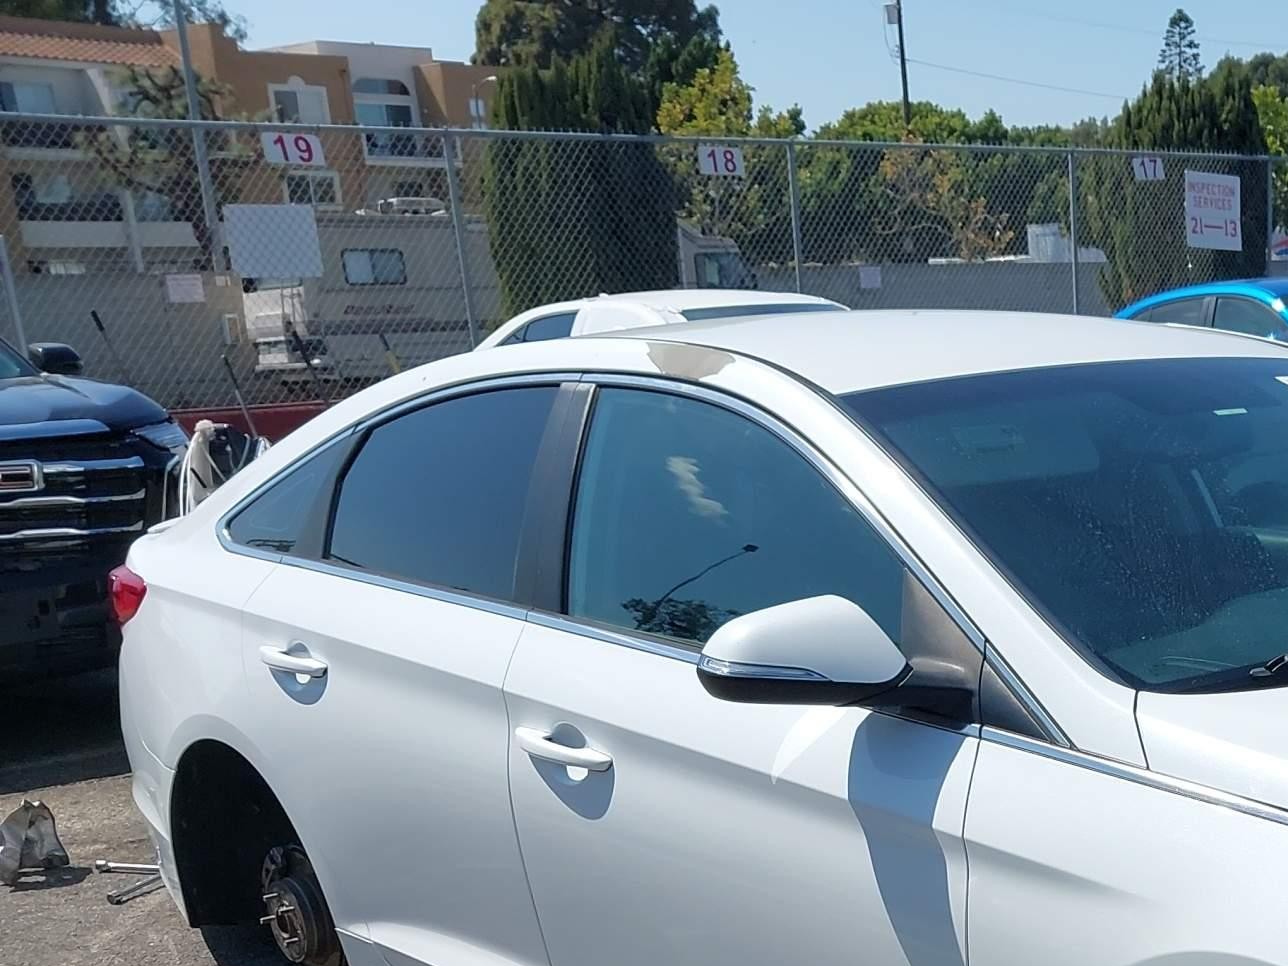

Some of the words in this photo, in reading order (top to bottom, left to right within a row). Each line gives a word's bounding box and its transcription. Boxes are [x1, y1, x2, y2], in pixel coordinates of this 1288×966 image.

[273, 135, 313, 163] 19
[707, 149, 737, 173] 18
[1140, 159, 1157, 178] 17
[1193, 196, 1232, 210] SERVICES
